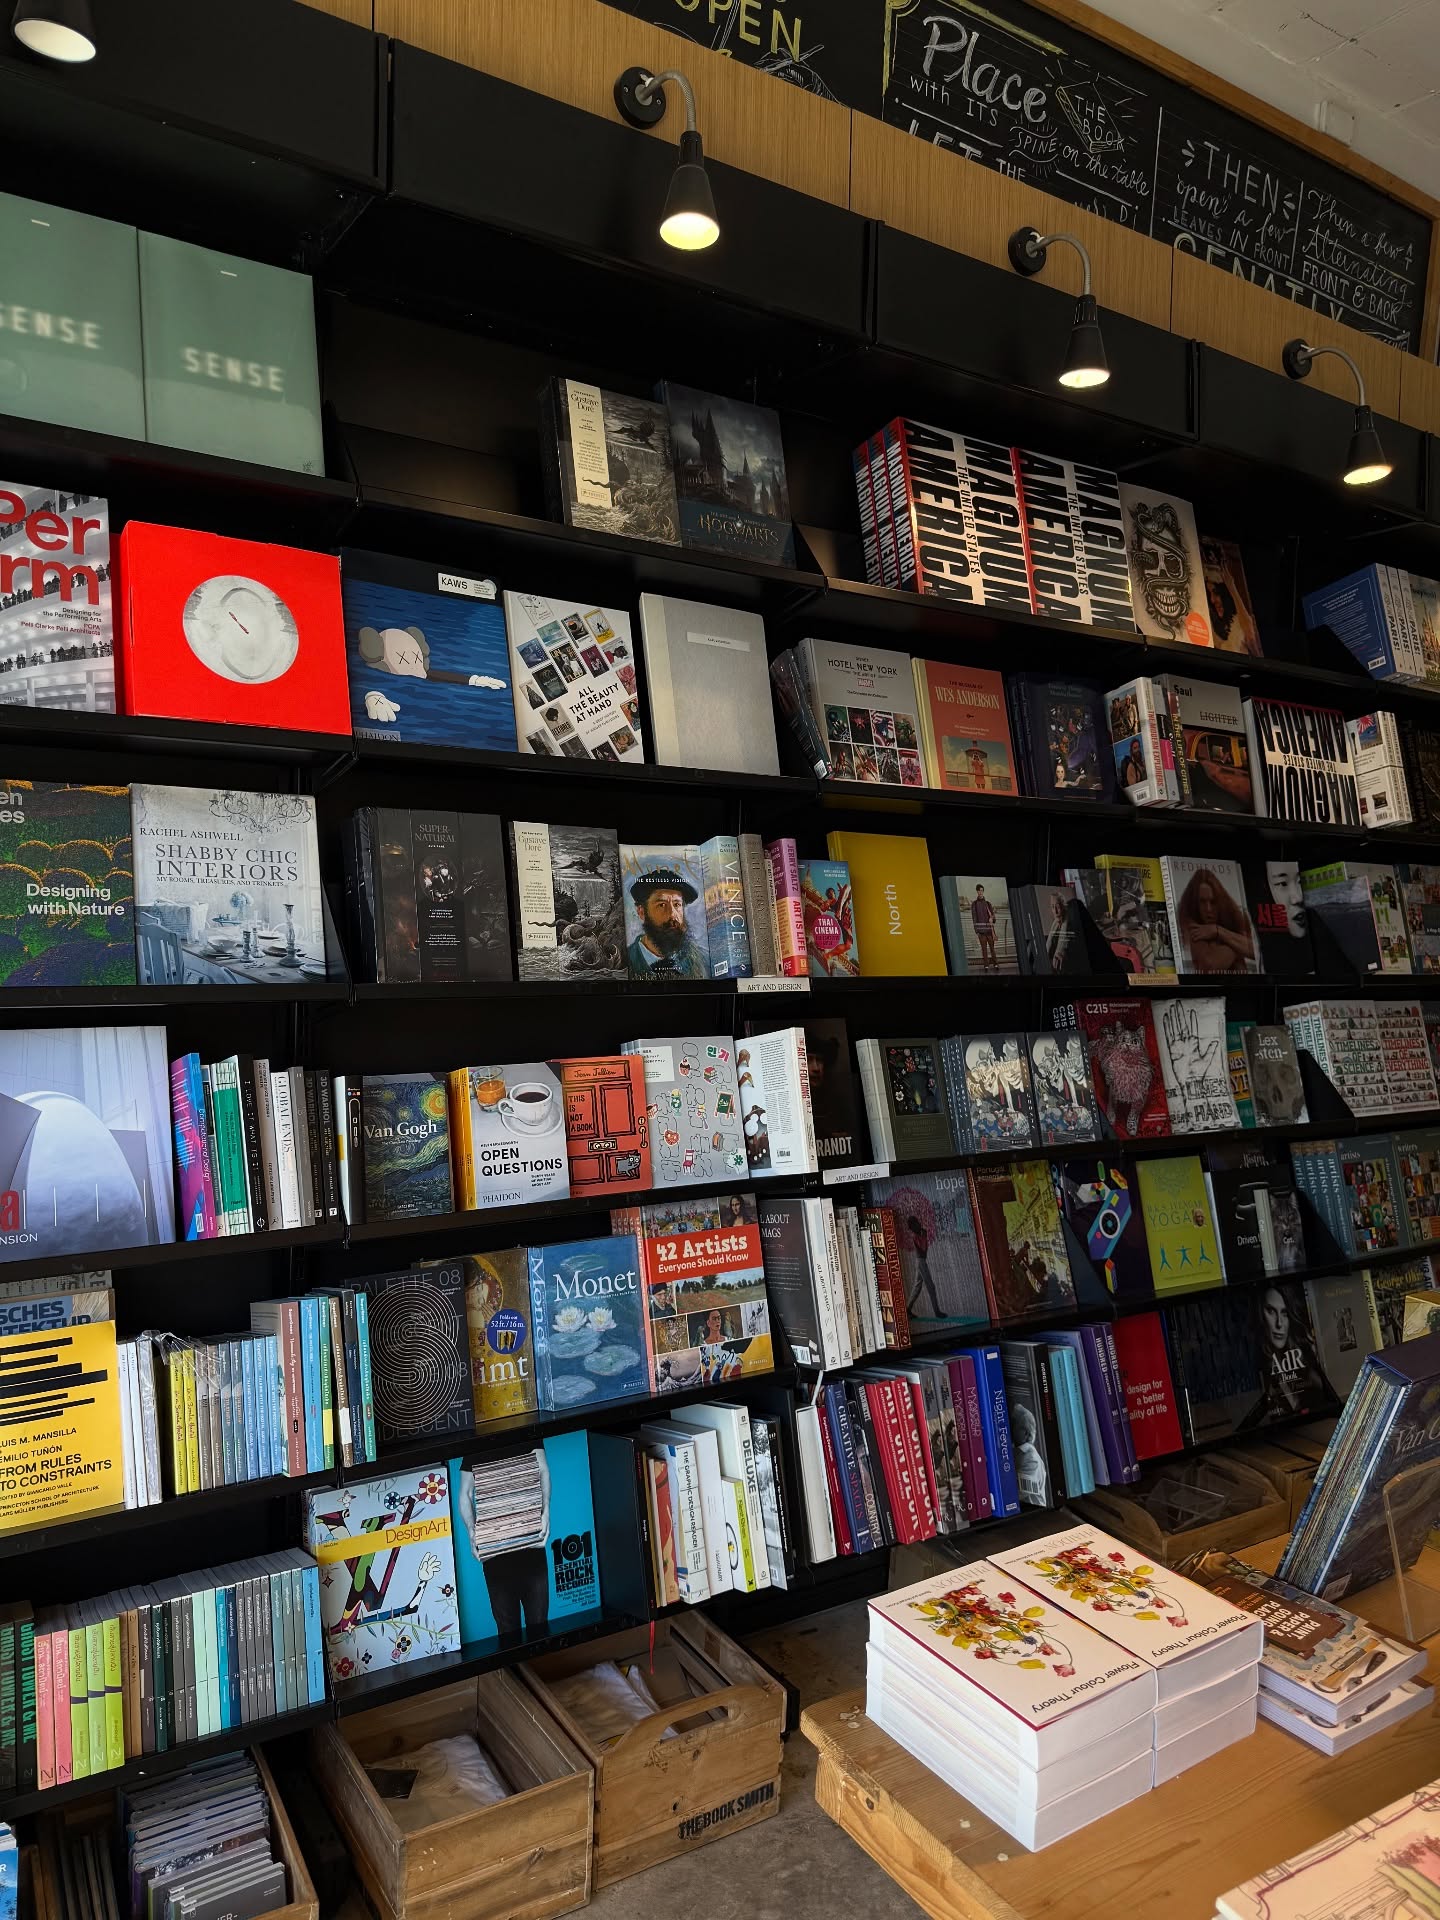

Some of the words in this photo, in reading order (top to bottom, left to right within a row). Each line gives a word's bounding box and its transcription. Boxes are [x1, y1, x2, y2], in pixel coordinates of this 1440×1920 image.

[922, 14, 1047, 123] Place
[1075, 95, 1107, 124] THE
[1203, 141, 1279, 215] THEN
[1173, 206, 1222, 241] LEAVES
[1229, 229, 1248, 253] IN
[1302, 260, 1350, 299] FRONT
[183, 347, 285, 393] SENSE
[886, 440, 908, 513] MAGNUM
[905, 421, 975, 603] AMERICA
[960, 489, 976, 531] UNITED
[699, 513, 780, 547] HOGWARTS
[966, 437, 1029, 608] MAGNUM
[1019, 449, 1083, 622] AMERICA
[895, 511, 917, 585] AMERICA
[967, 532, 981, 574] STATES
[1074, 465, 1136, 630] MAGNUM
[441, 577, 468, 590] KAWS
[827, 658, 854, 670] HOTEL
[857, 663, 874, 672] NEW
[876, 665, 898, 676] YORK
[569, 702, 588, 715] THE
[588, 683, 620, 706] BEAUTY
[578, 686, 595, 699] ALL
[935, 686, 954, 703] WES
[956, 689, 1000, 710] ANDERSON
[1173, 684, 1193, 697] Saul
[576, 711, 589, 724] AT
[588, 698, 613, 717] HAND
[1257, 701, 1349, 764] AMERICA
[1269, 764, 1360, 826] MAGNUM
[139, 827, 187, 839] RACHEL
[190, 830, 244, 842] ASHWELL
[414, 831, 456, 844] NATURAL
[518, 834, 547, 846] Gustave
[155, 843, 238, 861] SHABBY
[246, 848, 298, 864] CHIC
[524, 841, 543, 853] Doré
[787, 844, 796, 868] JERRY
[156, 860, 299, 881] INTERIORS
[1173, 861, 1233, 874] REDHEADS
[789, 869, 800, 892] SALTZ
[26, 883, 111, 900] Designing
[723, 860, 748, 942] VENICE
[28, 902, 66, 915] with
[68, 901, 125, 916] Nature
[792, 900, 802, 918] ART
[889, 884, 903, 936] North
[795, 920, 804, 930] IS
[814, 926, 840, 935] CINEMA
[817, 917, 834, 927] THAI
[796, 931, 807, 952] LIFE
[747, 983, 760, 991] ART
[762, 983, 776, 991] AND
[777, 982, 802, 991] DESIGN
[1066, 1004, 1076, 1026] C215
[1086, 1003, 1109, 1014] C215
[1335, 1040, 1376, 1051] TIMELINES
[1384, 1040, 1420, 1050] TIMELINES
[1400, 1050, 1408, 1060] OF
[1344, 1061, 1375, 1073] SCIENCE
[1352, 1052, 1361, 1062] OF
[1386, 1060, 1430, 1071] EVERYTHING
[320, 1076, 328, 1088] 3D
[322, 1089, 332, 1126] WARHOL
[568, 1094, 586, 1103] THIS
[569, 1105, 577, 1113] IS
[364, 1123, 394, 1139] Van
[397, 1118, 438, 1138] Gogh
[569, 1113, 584, 1123] NOT
[571, 1124, 577, 1132] A
[577, 1122, 594, 1132] BOOK
[480, 1147, 520, 1162] OPEN
[481, 1158, 564, 1177] QUESTIONS
[834, 1175, 848, 1183] ART
[848, 1174, 860, 1182] AND
[860, 1171, 880, 1180] DESIGN
[935, 1176, 966, 1193] hope
[483, 1191, 521, 1203] PHAIDON
[766, 1213, 790, 1225] ABOUT
[761, 1227, 782, 1239] MAGS
[656, 1242, 677, 1263] 42
[682, 1235, 748, 1259] Artists
[658, 1259, 697, 1275] Everyone
[696, 1256, 725, 1269] Should
[725, 1252, 749, 1265] Know
[439, 1269, 461, 1287] 08
[553, 1268, 638, 1303] Monet
[530, 1255, 549, 1352] Monet
[1270, 1349, 1306, 1377] AdR
[1126, 1380, 1151, 1395] design
[1152, 1379, 1163, 1390] for
[994, 1389, 1006, 1422] Night
[1136, 1398, 1142, 1406] a
[1143, 1393, 1165, 1404] better
[31, 1445, 63, 1458] TUÑÓN
[999, 1425, 1010, 1462] Fever
[0, 1462, 36, 1478] FROM
[41, 1453, 82, 1470] RULES
[742, 1439, 757, 1494] DELUXE
[838, 1403, 856, 1470] CREATIVE
[849, 1472, 864, 1522] SPACES
[0, 1479, 17, 1491] TO
[19, 1459, 112, 1487] CONSTRAINTS
[26, 1485, 56, 1496] GIANCARLO
[31, 1496, 53, 1505] SCHOOL
[61, 1485, 100, 1498] ARCHITECTURE
[865, 1492, 882, 1544] COUNTRY
[386, 1519, 448, 1544] DesignArt
[1044, 1528, 1099, 1551] PHAIDON
[551, 1531, 593, 1565] 101
[555, 1556, 593, 1572] ESSENTIAL
[555, 1564, 594, 1584] ROCK
[556, 1576, 596, 1593] RECORDS
[931, 1565, 991, 1590] PHAIDON
[1215, 1613, 1248, 1632] Flower
[1278, 1610, 1311, 1632] PAPER
[1288, 1620, 1321, 1641] PAINT,
[1187, 1627, 1217, 1643] Colour
[1269, 1629, 1280, 1637] &
[1151, 1639, 1188, 1658] Theory
[1106, 1660, 1140, 1681] Flower
[1070, 1676, 1106, 1696] Colour
[1032, 1692, 1072, 1713] Theory
[679, 1818, 701, 1840] THE
[702, 1800, 735, 1829] BOOK
[736, 1781, 775, 1814] SMITH
